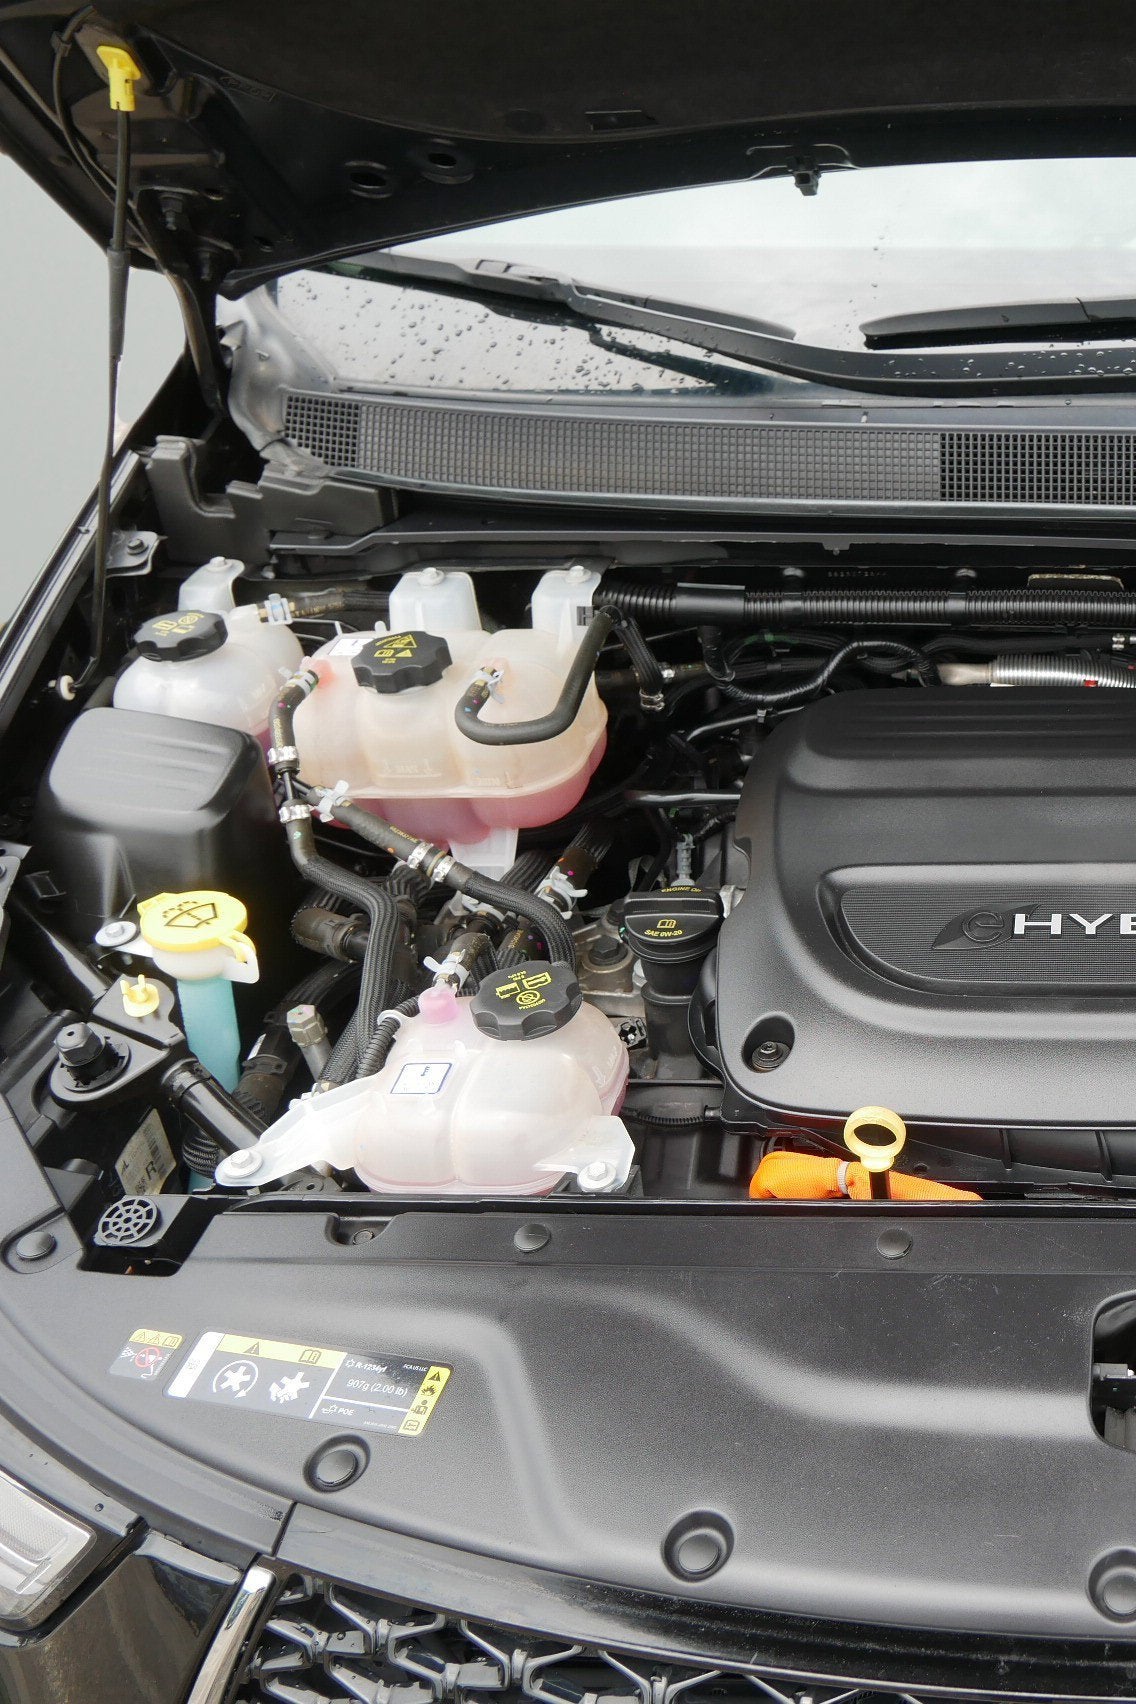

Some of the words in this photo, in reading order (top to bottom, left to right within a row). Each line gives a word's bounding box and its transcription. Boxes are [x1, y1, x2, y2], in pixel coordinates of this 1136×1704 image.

[644, 929, 660, 937] SAE
[346, 1378, 370, 1391] 907g
[338, 1407, 355, 1416] POE
